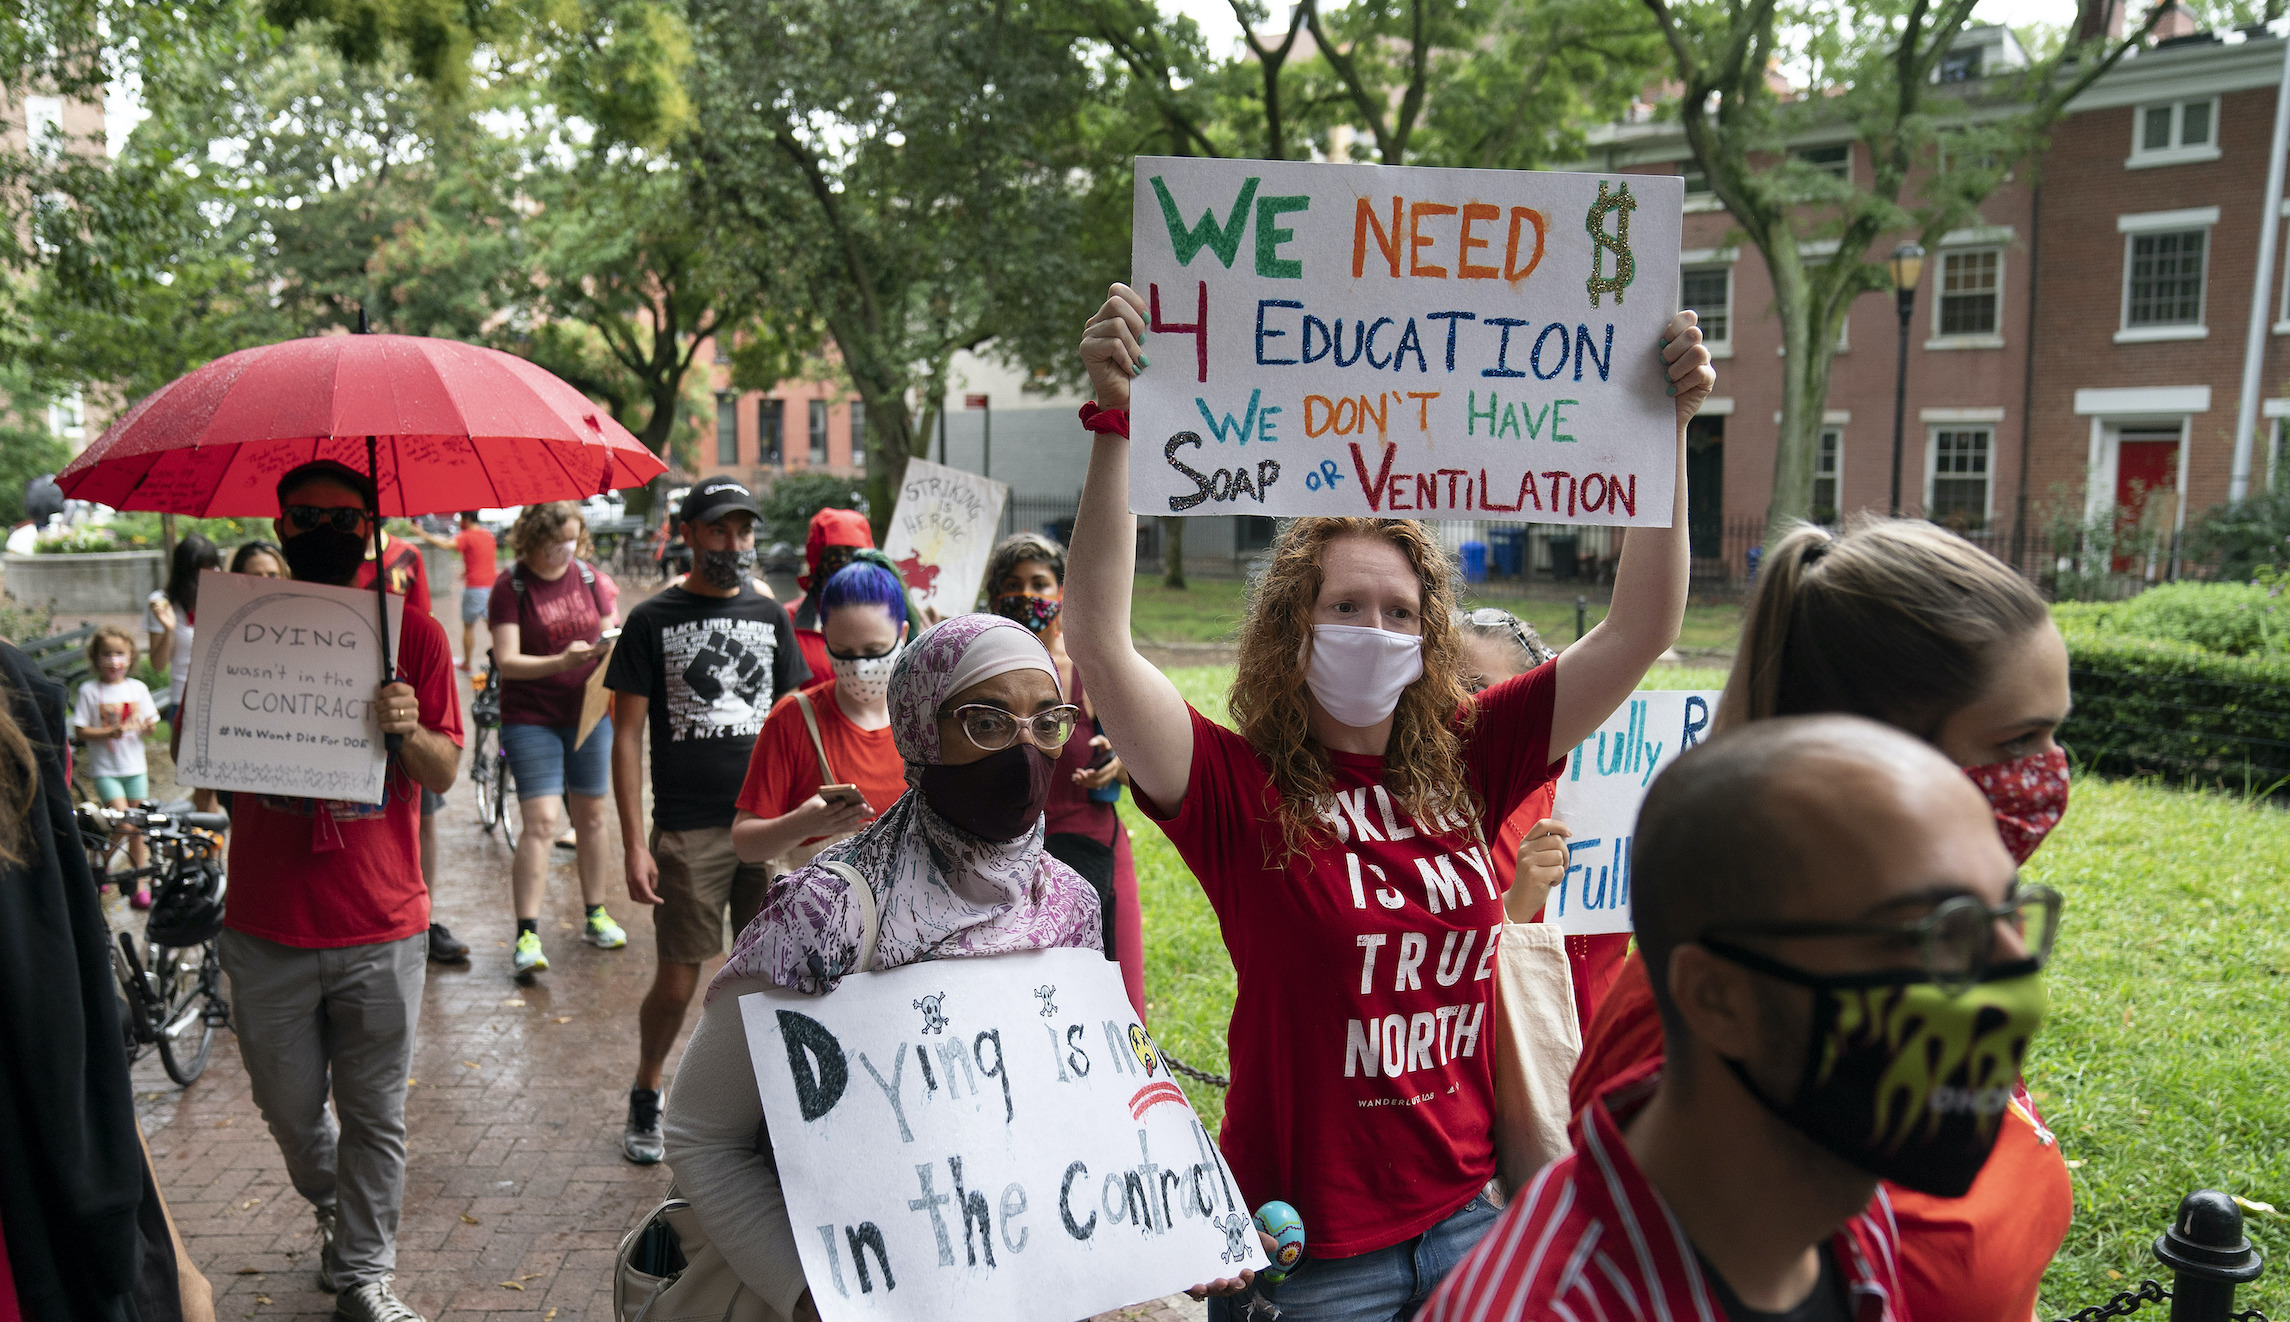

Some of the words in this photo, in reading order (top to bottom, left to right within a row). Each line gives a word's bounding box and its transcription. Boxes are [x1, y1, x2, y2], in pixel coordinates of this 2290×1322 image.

[1149, 175, 1310, 279] WE
[1351, 195, 1546, 281] NEED
[1149, 281, 1208, 382] 4
[1256, 299, 1614, 382] EDUCATION
[1195, 388, 1283, 446] WE
[1304, 391, 1441, 440] DON'T
[1468, 391, 1579, 443] HAVE
[905, 475, 985, 523] STRIKING
[1164, 430, 1280, 512] SOAP
[1349, 441, 1637, 517] VENTILATION
[938, 500, 952, 513] IS
[244, 622, 357, 650] DYING
[662, 620, 698, 640] BLACK
[702, 617, 733, 632] LIVES
[736, 618, 776, 635] MATTER
[227, 663, 287, 680] wasn't
[298, 669, 314, 685] in
[322, 671, 353, 688] the
[242, 689, 377, 721] CONTRACT
[296, 732, 316, 744] Die
[320, 735, 340, 746] For
[343, 737, 369, 749] DOE
[694, 726, 725, 740] NYC
[1346, 852, 1405, 909] IS
[1414, 847, 1498, 914] MY
[1558, 836, 1632, 921] Full
[1356, 922, 1503, 994] TRUE
[1344, 1002, 1485, 1078] NORTH
[774, 1008, 1014, 1143] Dying
[1045, 1022, 1091, 1082] is
[907, 1154, 1028, 1270] the
